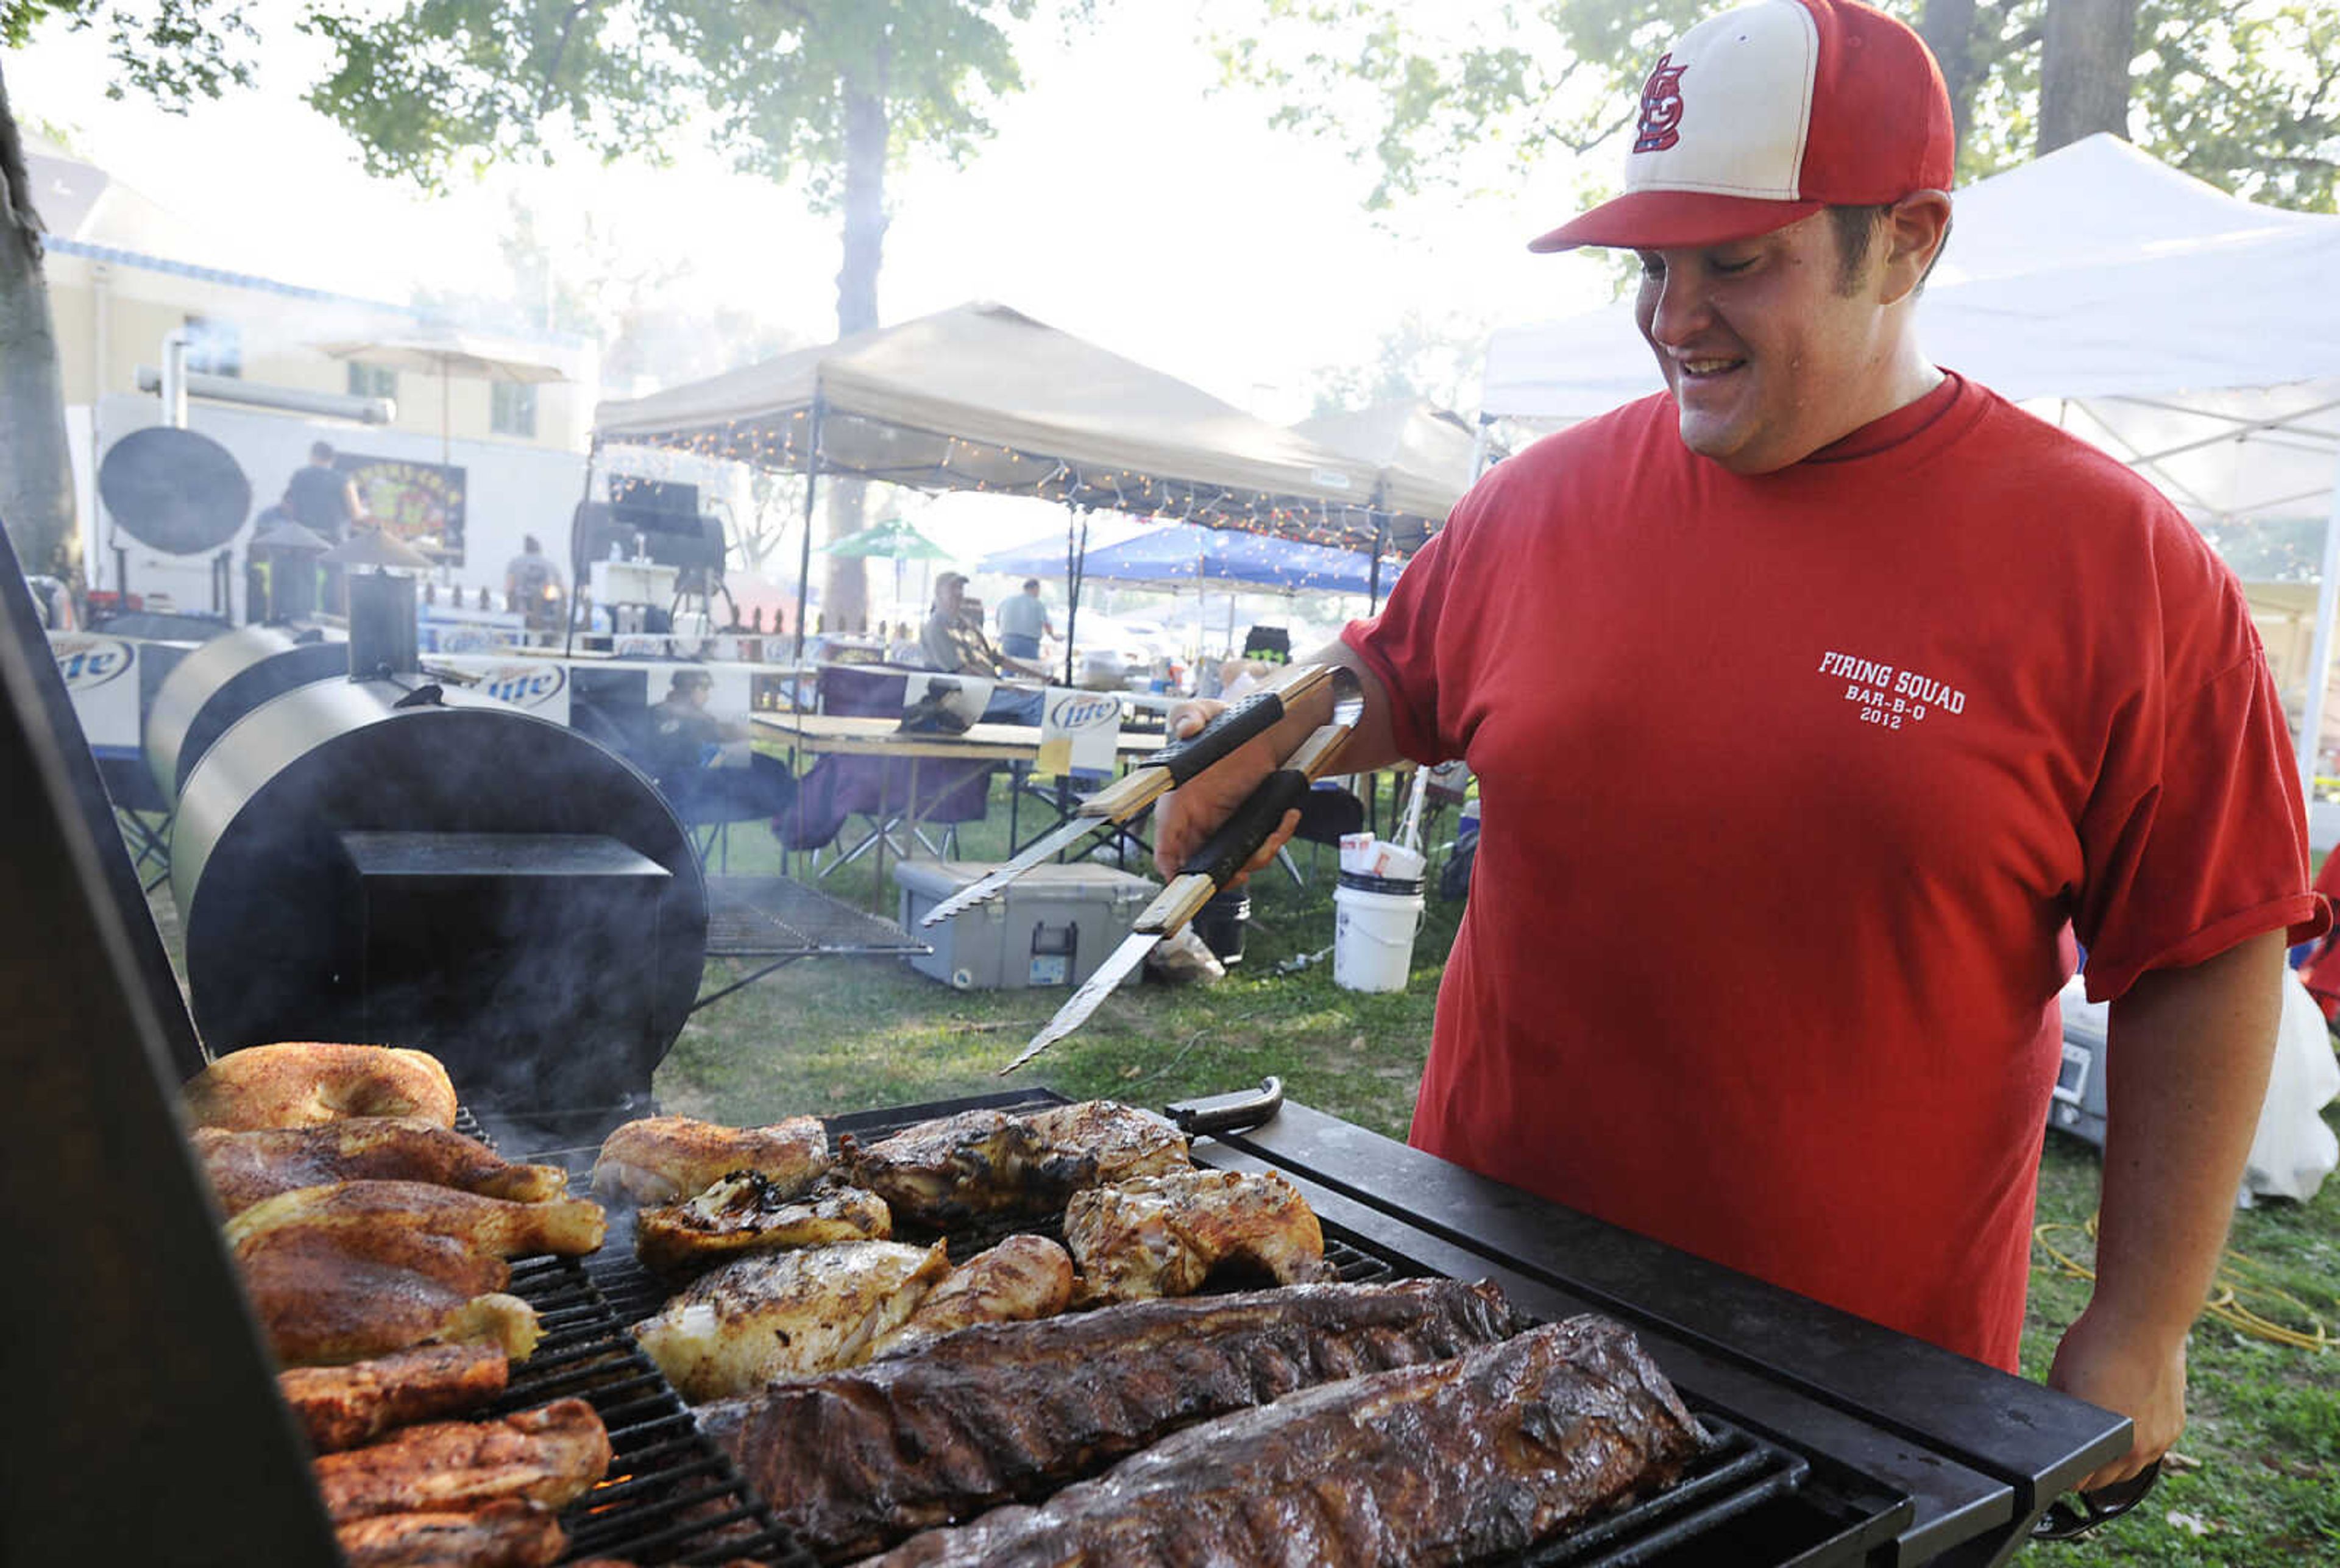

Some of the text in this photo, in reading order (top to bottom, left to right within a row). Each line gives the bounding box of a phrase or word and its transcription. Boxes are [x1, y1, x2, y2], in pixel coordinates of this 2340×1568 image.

[1818, 651, 1966, 715] FIRING SQUAD
[1860, 706, 1902, 730] 2012
